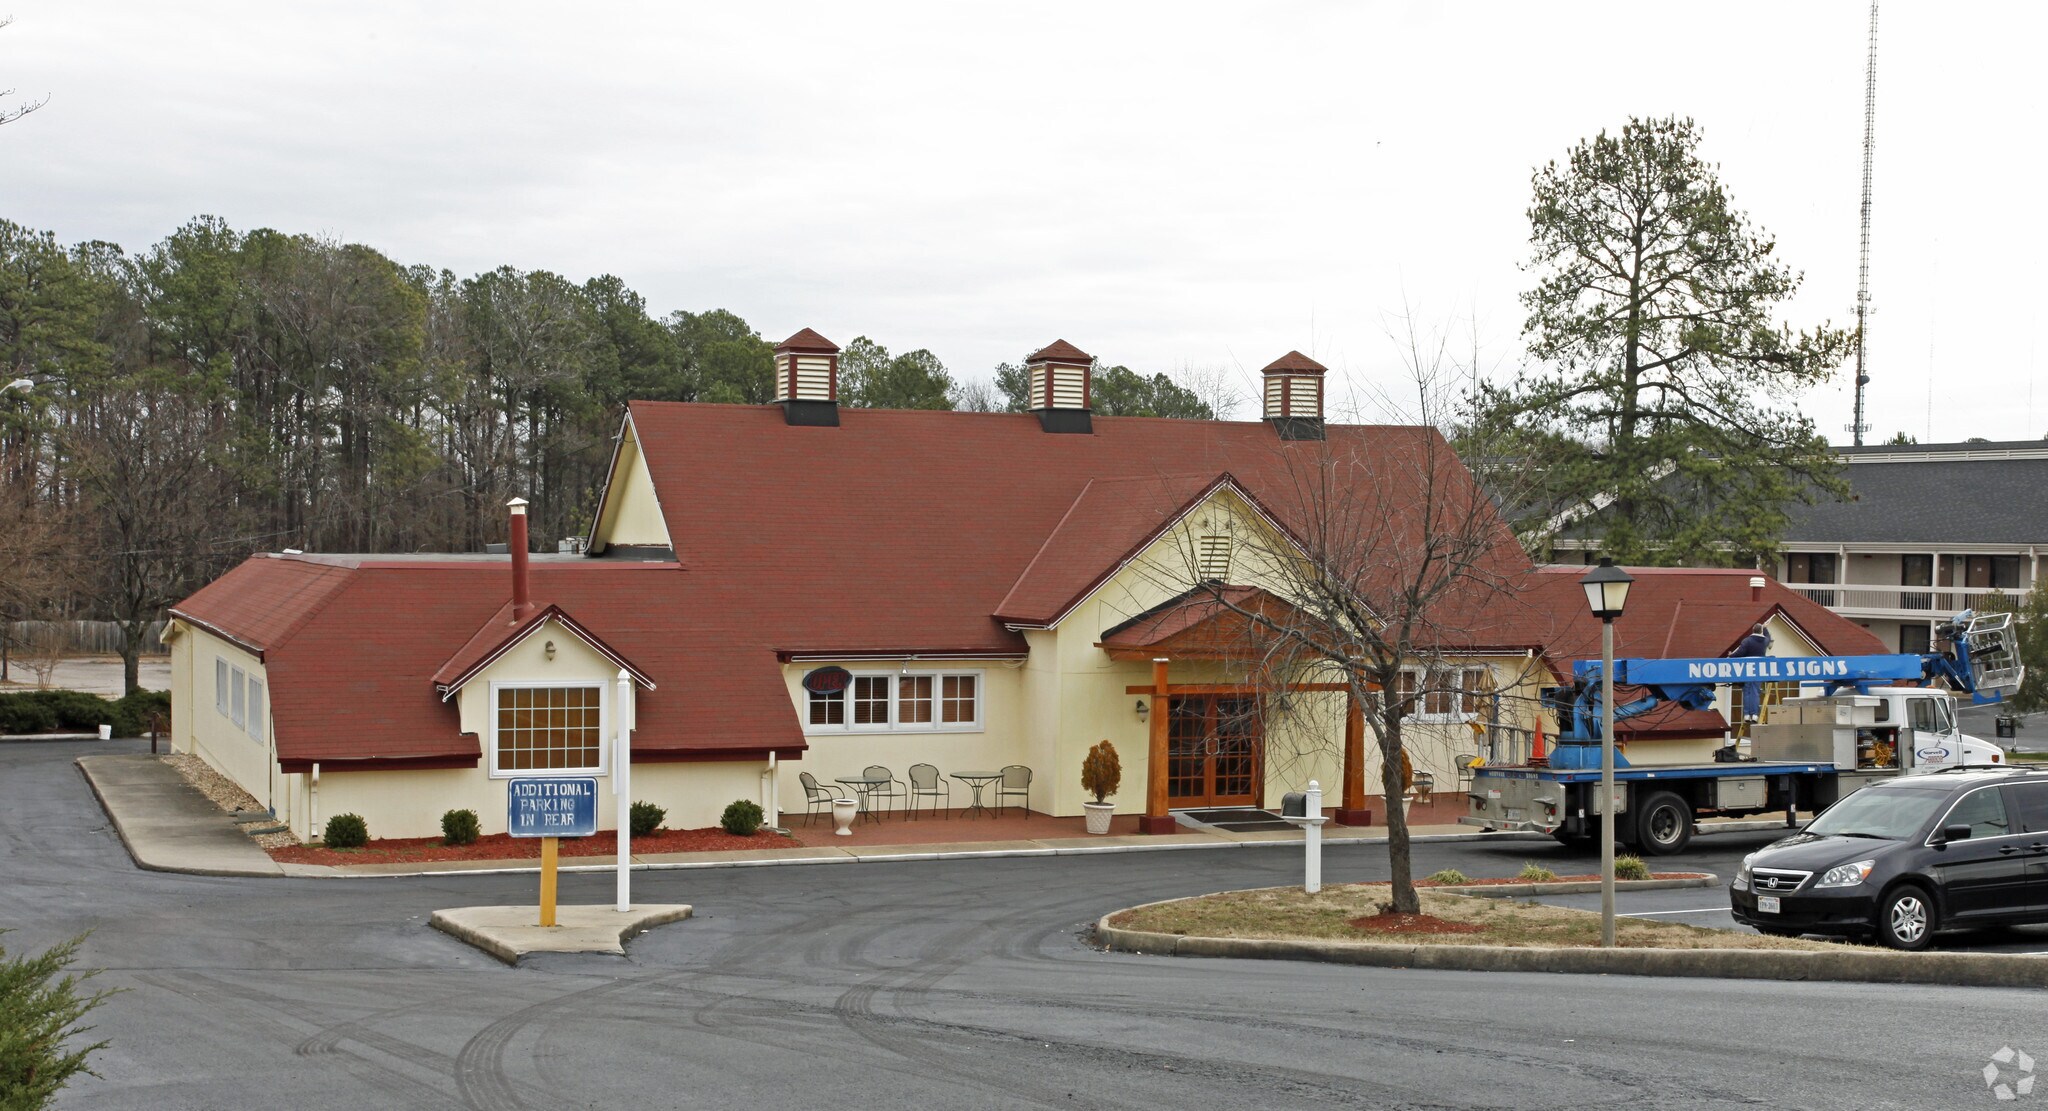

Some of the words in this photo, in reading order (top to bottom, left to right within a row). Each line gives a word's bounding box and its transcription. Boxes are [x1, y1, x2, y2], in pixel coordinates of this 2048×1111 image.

[1688, 661, 1781, 679] NORVELL
[1786, 660, 1848, 677] SIGNS
[514, 783, 591, 797] ADDITIONAL
[520, 798, 575, 811] PARKING
[520, 814, 534, 827] IN
[544, 813, 575, 826] REAR
